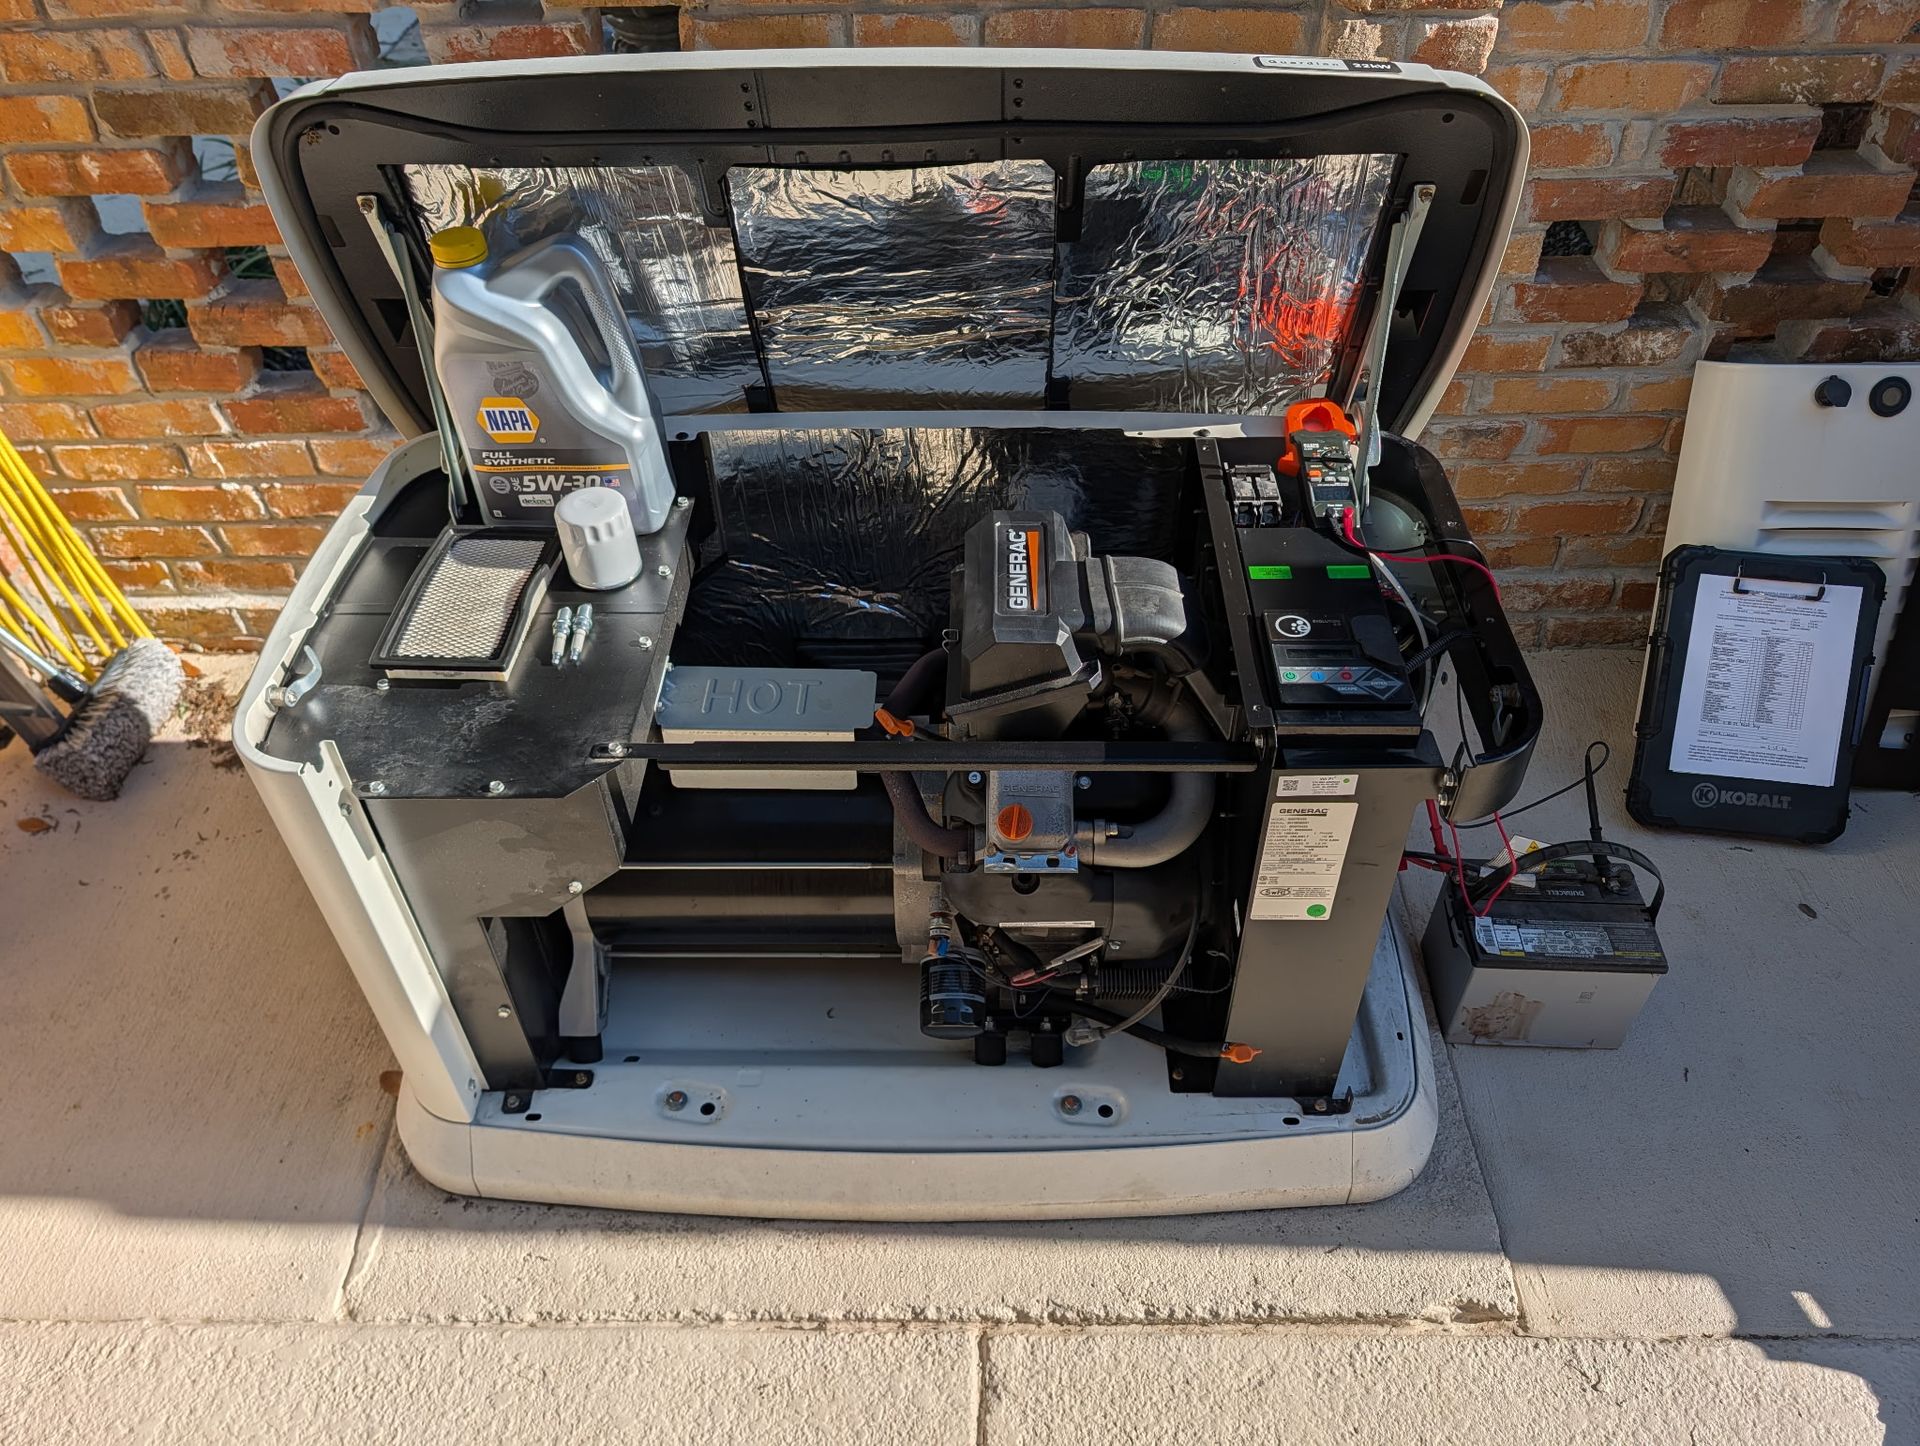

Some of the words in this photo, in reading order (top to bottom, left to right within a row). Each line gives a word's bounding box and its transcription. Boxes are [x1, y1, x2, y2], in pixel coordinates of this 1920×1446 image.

[1268, 59, 1340, 67] Guardian
[1352, 62, 1392, 70] 22kW
[485, 410, 533, 431] NAPA
[481, 451, 514, 459] FULL
[484, 456, 556, 465] SYNTHETIC
[511, 477, 523, 492] SAE
[522, 475, 601, 492] 5W-30
[1009, 530, 1028, 609] GENERAC
[701, 679, 823, 715] HOT
[1002, 784, 1060, 792] GENERAC
[1719, 790, 1791, 809] KOBALT
[1546, 889, 1585, 897] DURACELL
